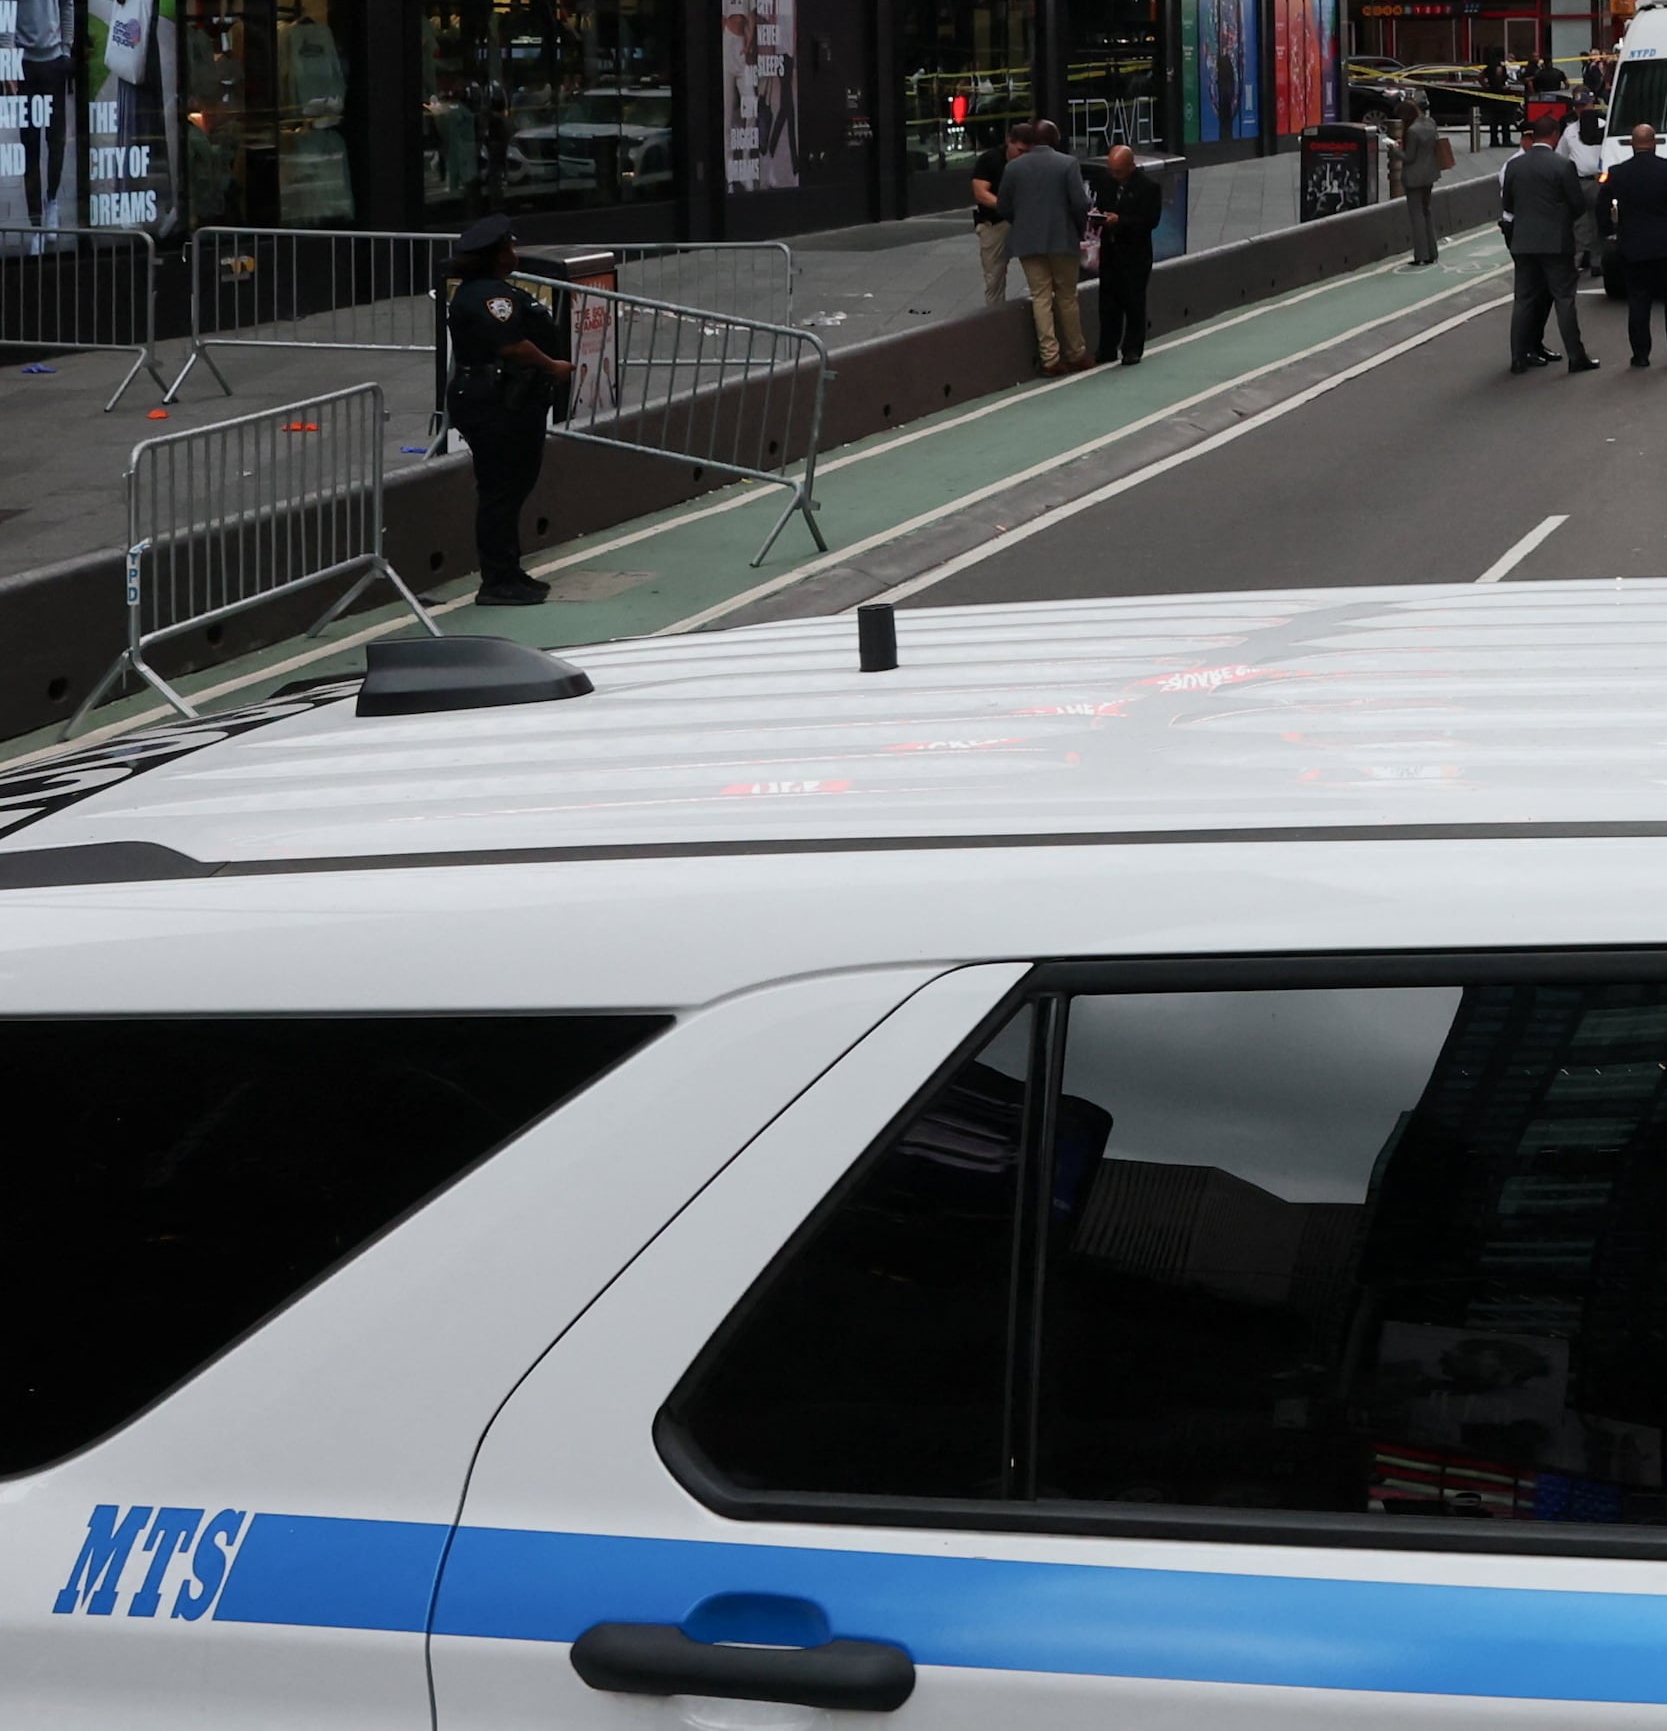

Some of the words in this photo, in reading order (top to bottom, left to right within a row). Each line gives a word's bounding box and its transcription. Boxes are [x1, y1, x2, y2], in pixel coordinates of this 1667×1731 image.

[757, 54, 785, 78] SLEEPS
[1629, 48, 1657, 59] NYPD
[31, 94, 53, 128] OF
[89, 101, 117, 134] THE
[1068, 97, 1163, 151] TRAVEL
[89, 147, 126, 180] CITY
[129, 145, 150, 178] OF
[89, 191, 157, 226] DREAMS
[51, 1503, 246, 1622] MTS
